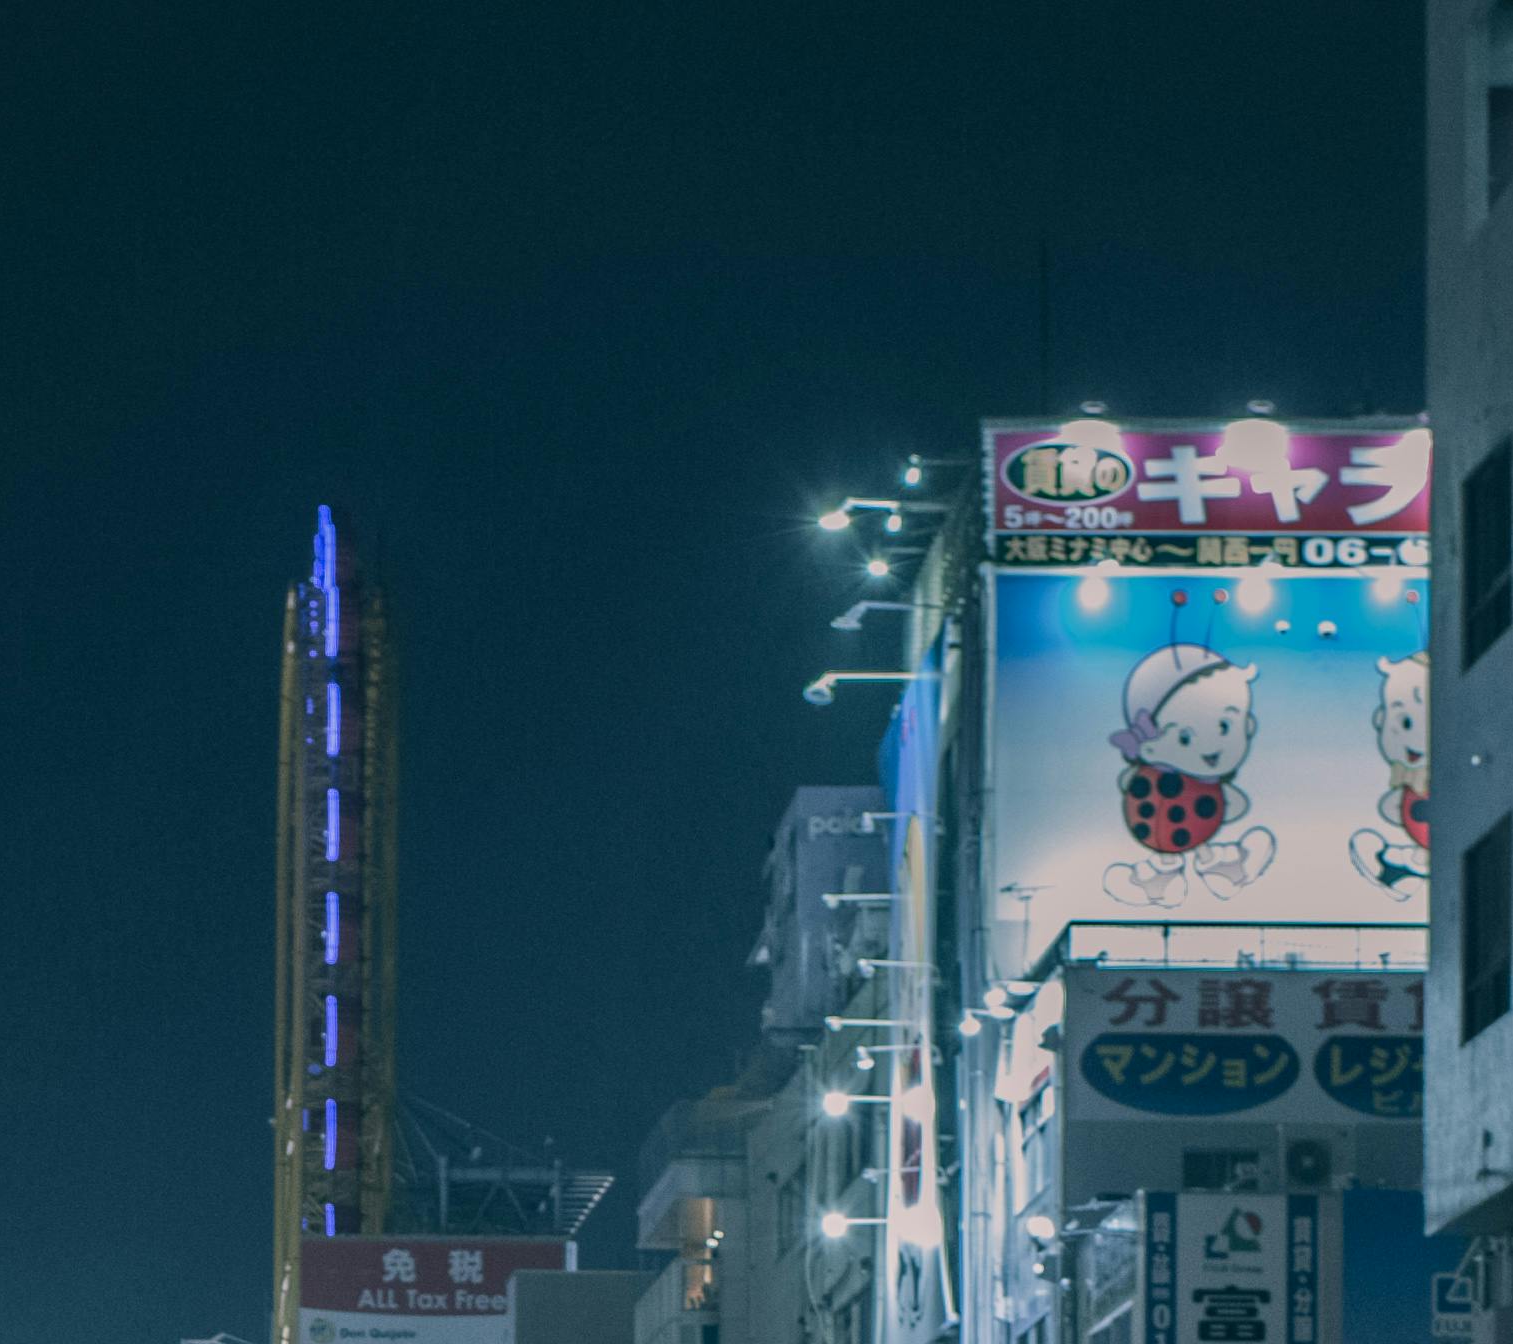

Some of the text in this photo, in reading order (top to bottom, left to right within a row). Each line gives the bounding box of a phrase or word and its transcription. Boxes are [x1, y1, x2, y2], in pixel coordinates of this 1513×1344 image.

[1101, 977, 1276, 1029] 分譲
[1095, 1043, 1290, 1089] マンション
[381, 1247, 484, 1285] 免税
[406, 1288, 448, 1311] Tax
[454, 1289, 506, 1312] Free
